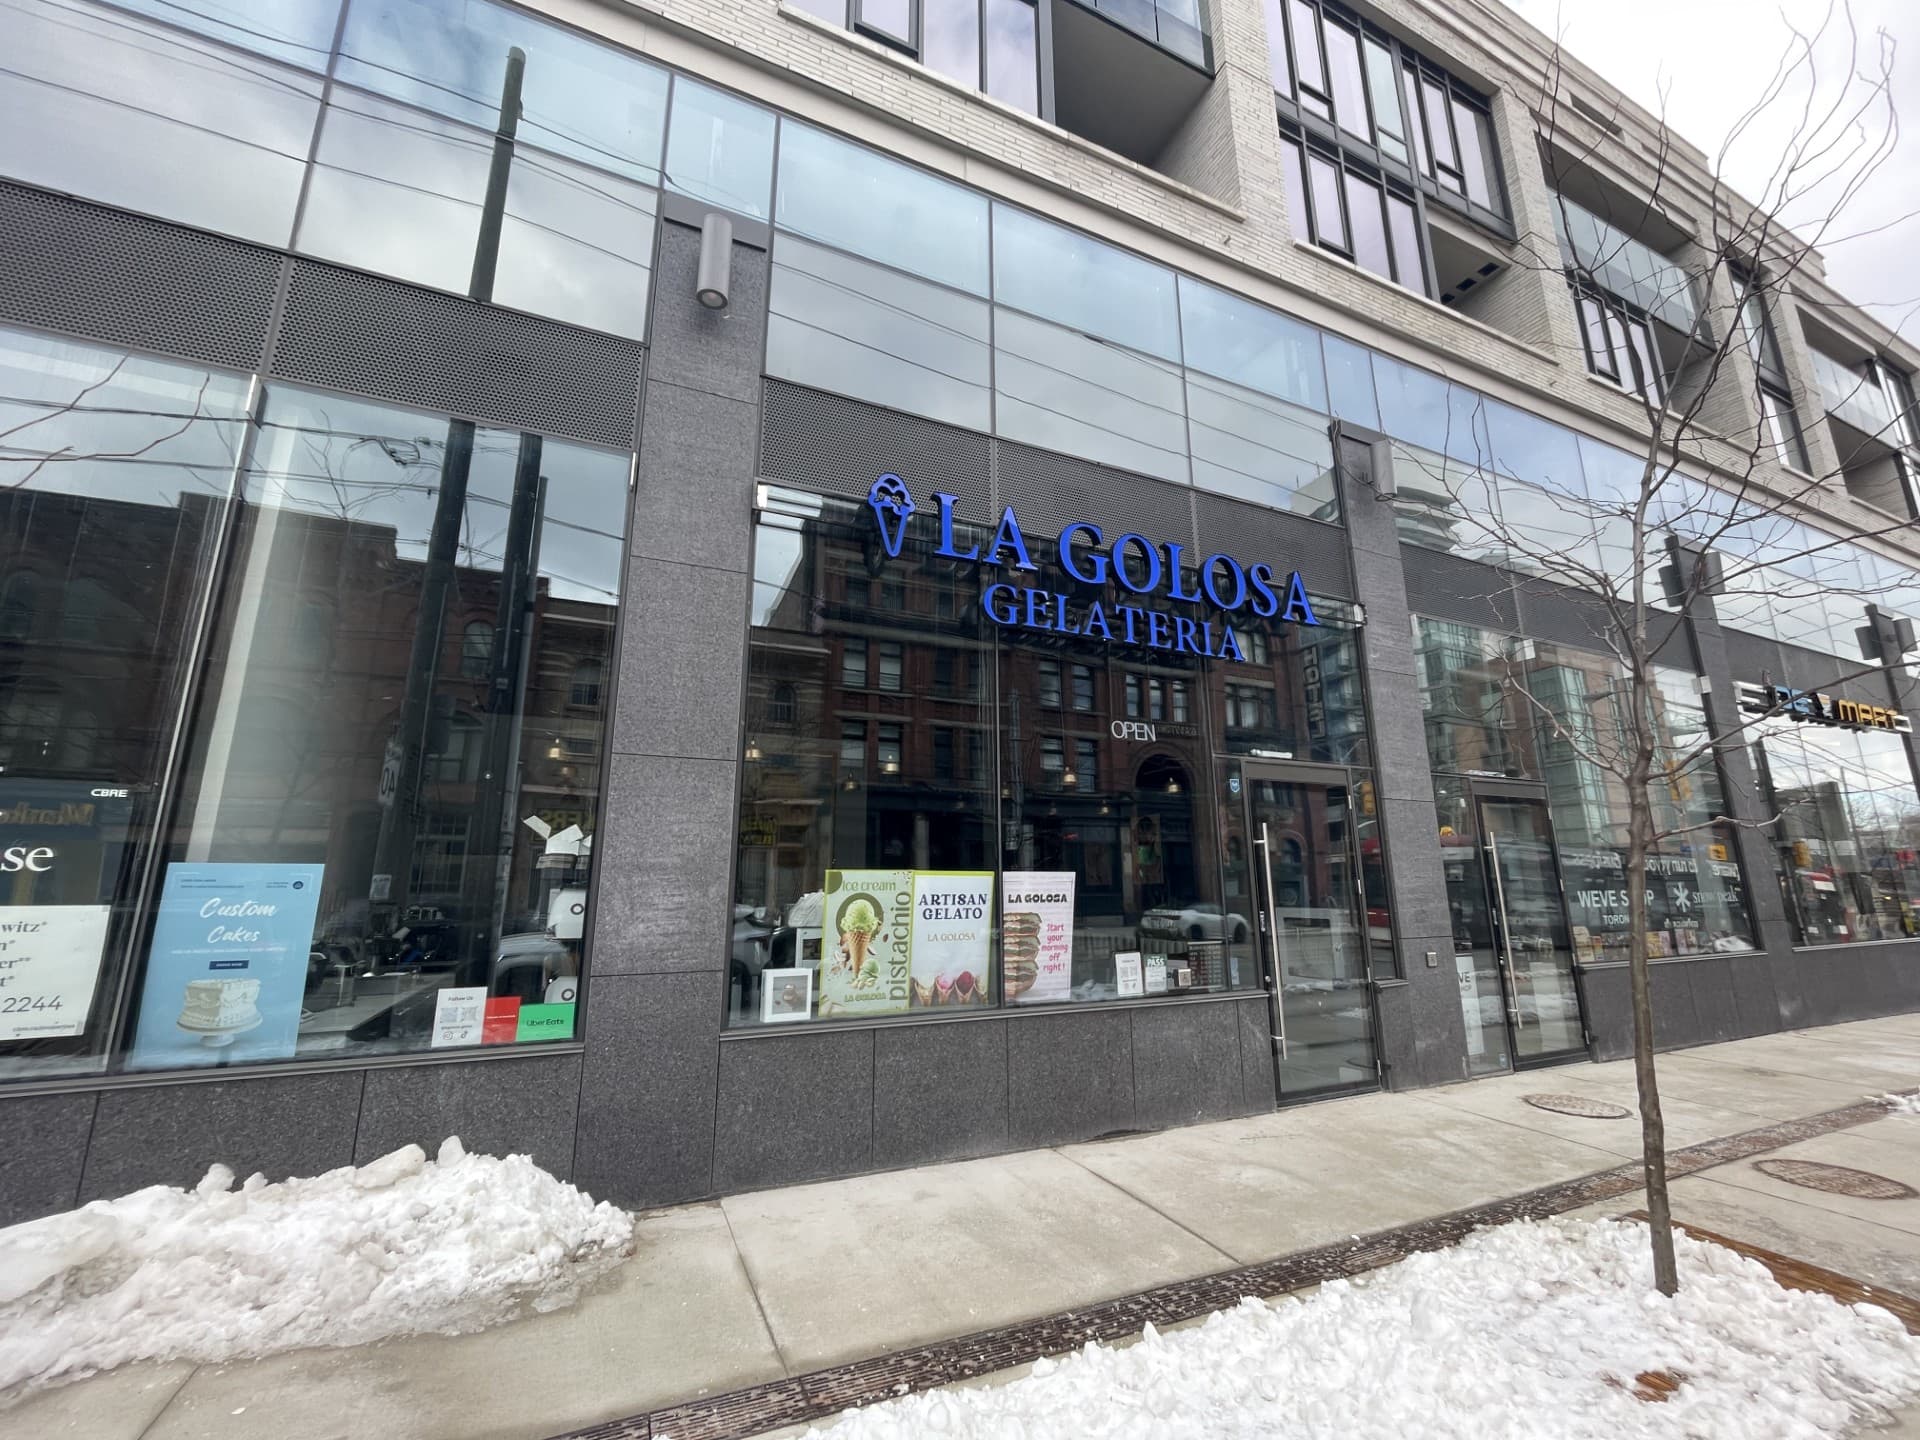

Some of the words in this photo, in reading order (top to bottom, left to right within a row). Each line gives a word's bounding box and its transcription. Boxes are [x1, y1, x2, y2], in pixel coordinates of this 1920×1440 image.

[931, 491, 1039, 573] LA
[1057, 521, 1321, 626] GOLOSA
[982, 583, 1245, 663] GELATERIA
[1111, 720, 1157, 742] OPEN
[90, 788, 129, 798] CBRE
[860, 882, 897, 892] cream
[918, 893, 988, 906] ARTISAN
[1008, 894, 1023, 904] LA
[1024, 893, 1068, 903] GOLOSA
[1577, 889, 1618, 908] WEVE
[1619, 890, 1655, 906] SP
[200, 897, 279, 919] Custom
[922, 907, 983, 920] GELATO
[207, 925, 260, 944] Cakes
[927, 934, 939, 942] LA
[940, 933, 976, 942] GOLOSA
[1046, 934, 1064, 944] your
[887, 891, 913, 1001] pistachio
[1041, 944, 1069, 954] morning
[1048, 953, 1061, 961] off
[1147, 958, 1166, 967] PASS
[1, 994, 64, 1013] 2244
[526, 1019, 545, 1027] Uber
[545, 1018, 565, 1026] Eats
